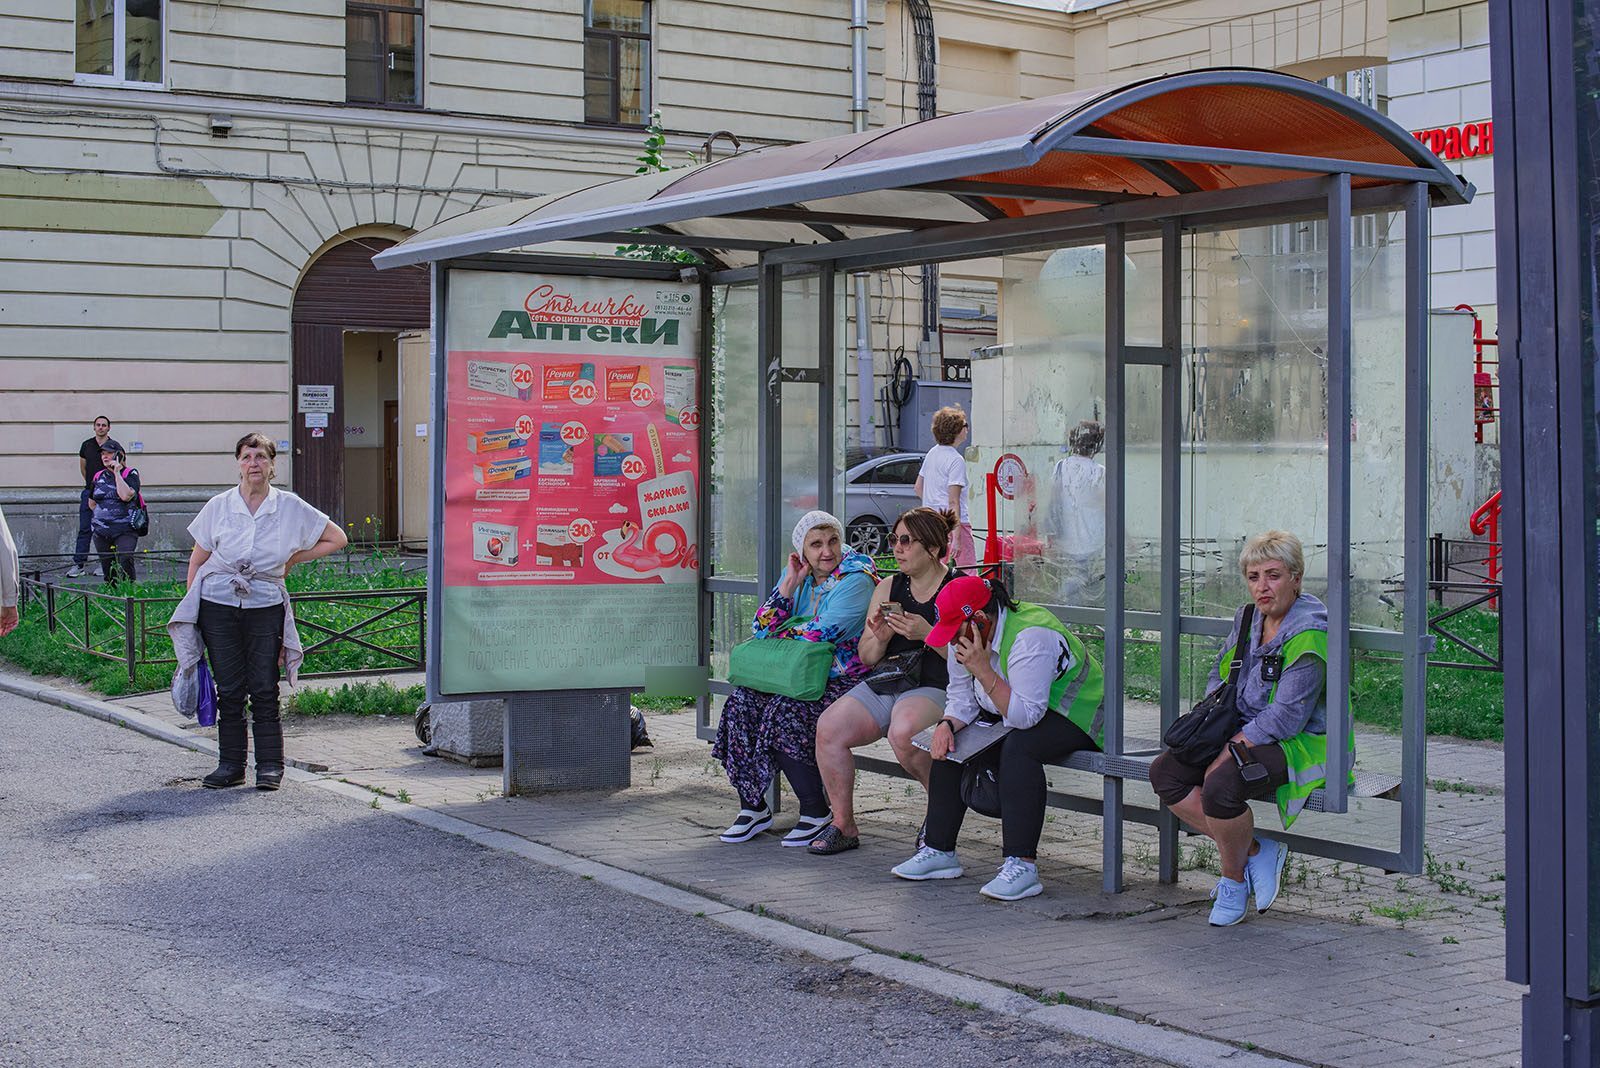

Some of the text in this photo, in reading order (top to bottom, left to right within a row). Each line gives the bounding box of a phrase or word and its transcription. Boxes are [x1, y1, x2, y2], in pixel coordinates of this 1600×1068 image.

[524, 284, 650, 317] Столички
[531, 314, 640, 327] сеть социальных аптек
[643, 485, 687, 503] ЖАРКИЕ
[647, 501, 690, 518] СКИДКИ
[630, 621, 697, 642] НЕОБХОДИМО
[467, 644, 697, 672] ПОЛУЧЕНИЕ КОНСУЛЬТАЦИИ СПЕЦИАЛИСТА
